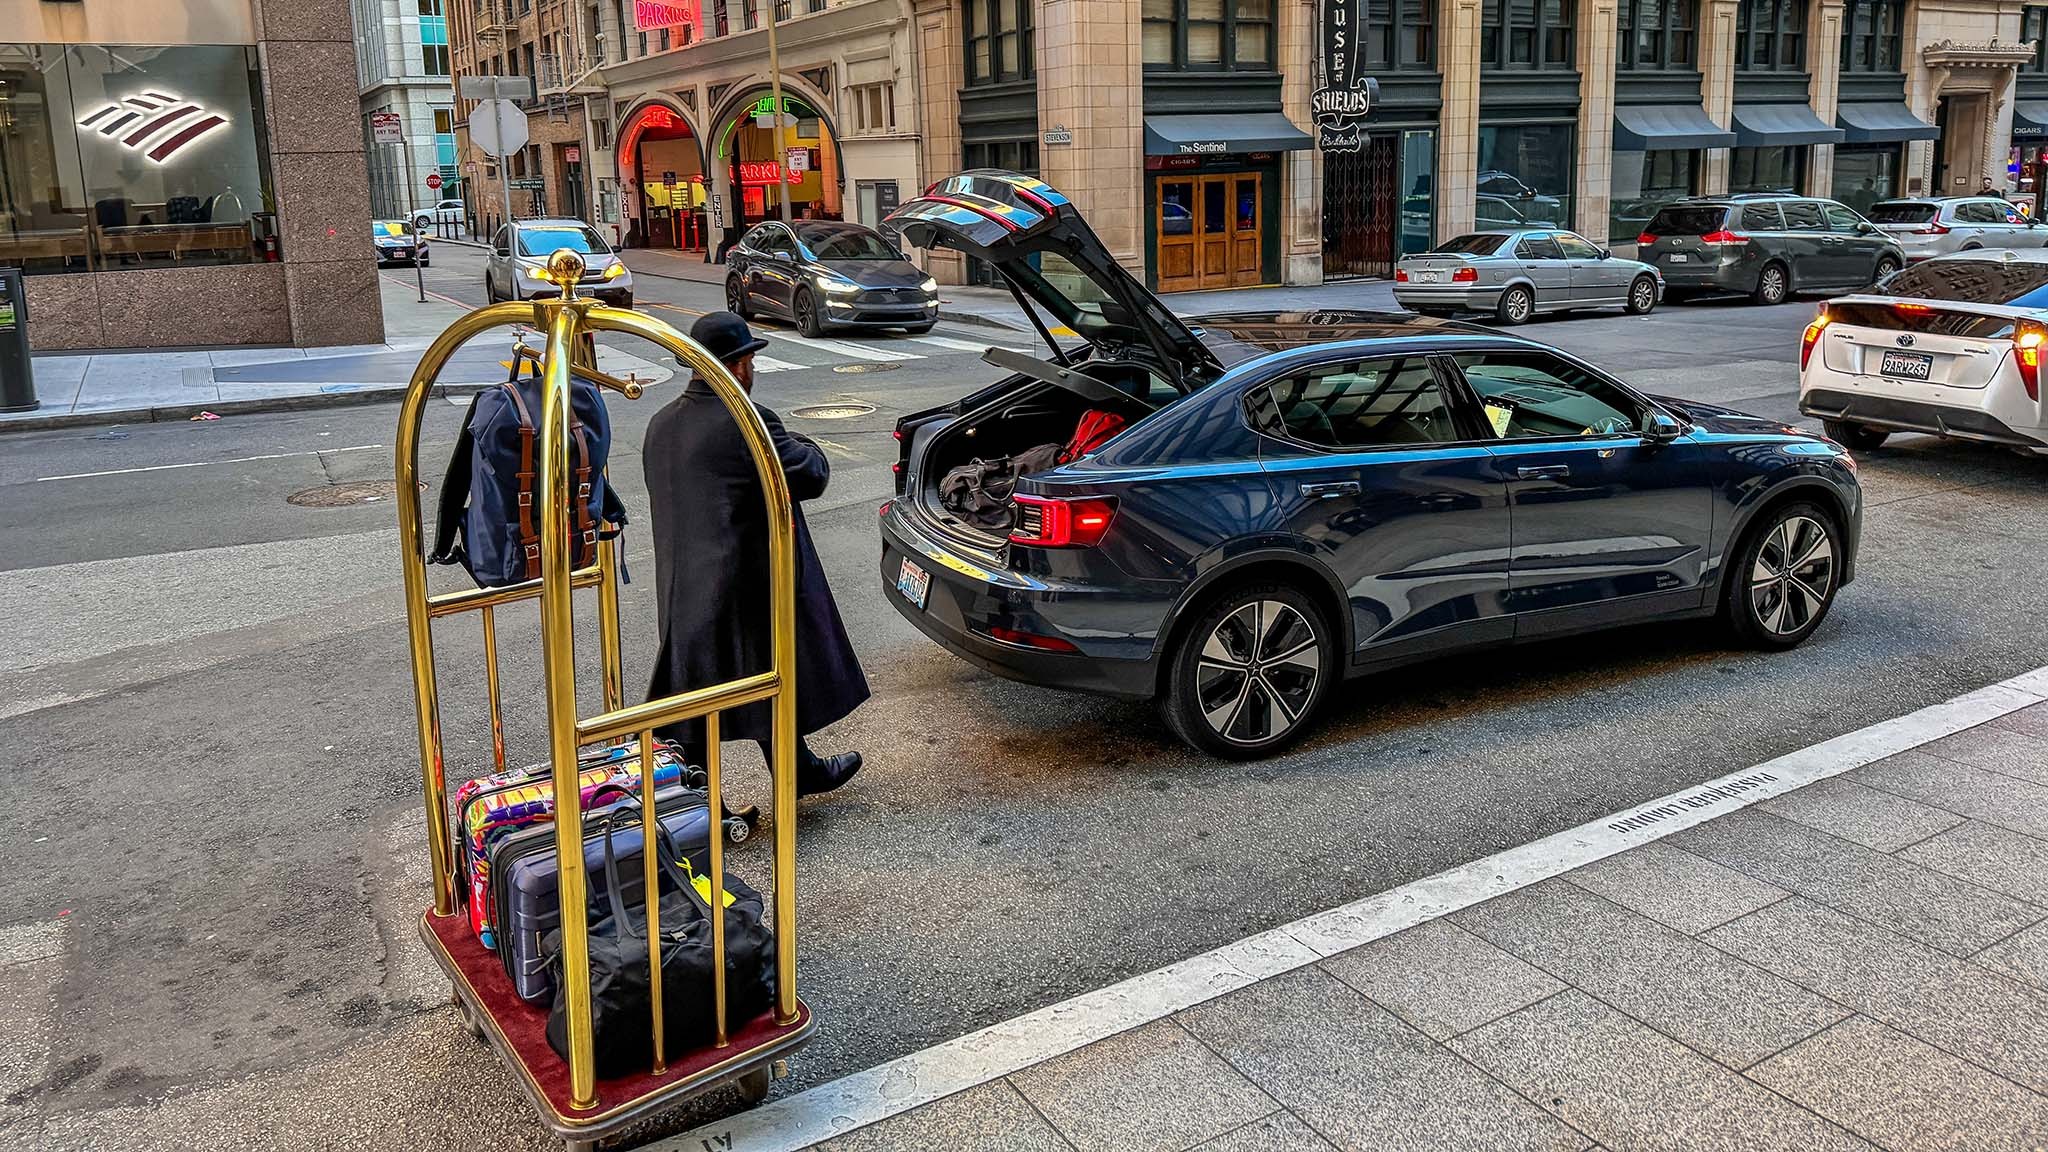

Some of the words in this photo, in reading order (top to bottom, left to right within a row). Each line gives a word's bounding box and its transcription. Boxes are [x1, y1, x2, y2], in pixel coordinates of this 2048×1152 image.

[637, 1, 690, 28] PARKING
[1313, 89, 1367, 113] SHIELDS
[1045, 133, 1070, 142] STEVENSON
[1180, 145, 1192, 153] The
[1193, 142, 1227, 153] Sentinel
[1322, 134, 1358, 147] Cocktails
[740, 163, 801, 178] ARKI
[714, 195, 722, 228] ENTER
[1679, 772, 1778, 808] PASSENGER
[1608, 804, 1689, 834] LOADING
